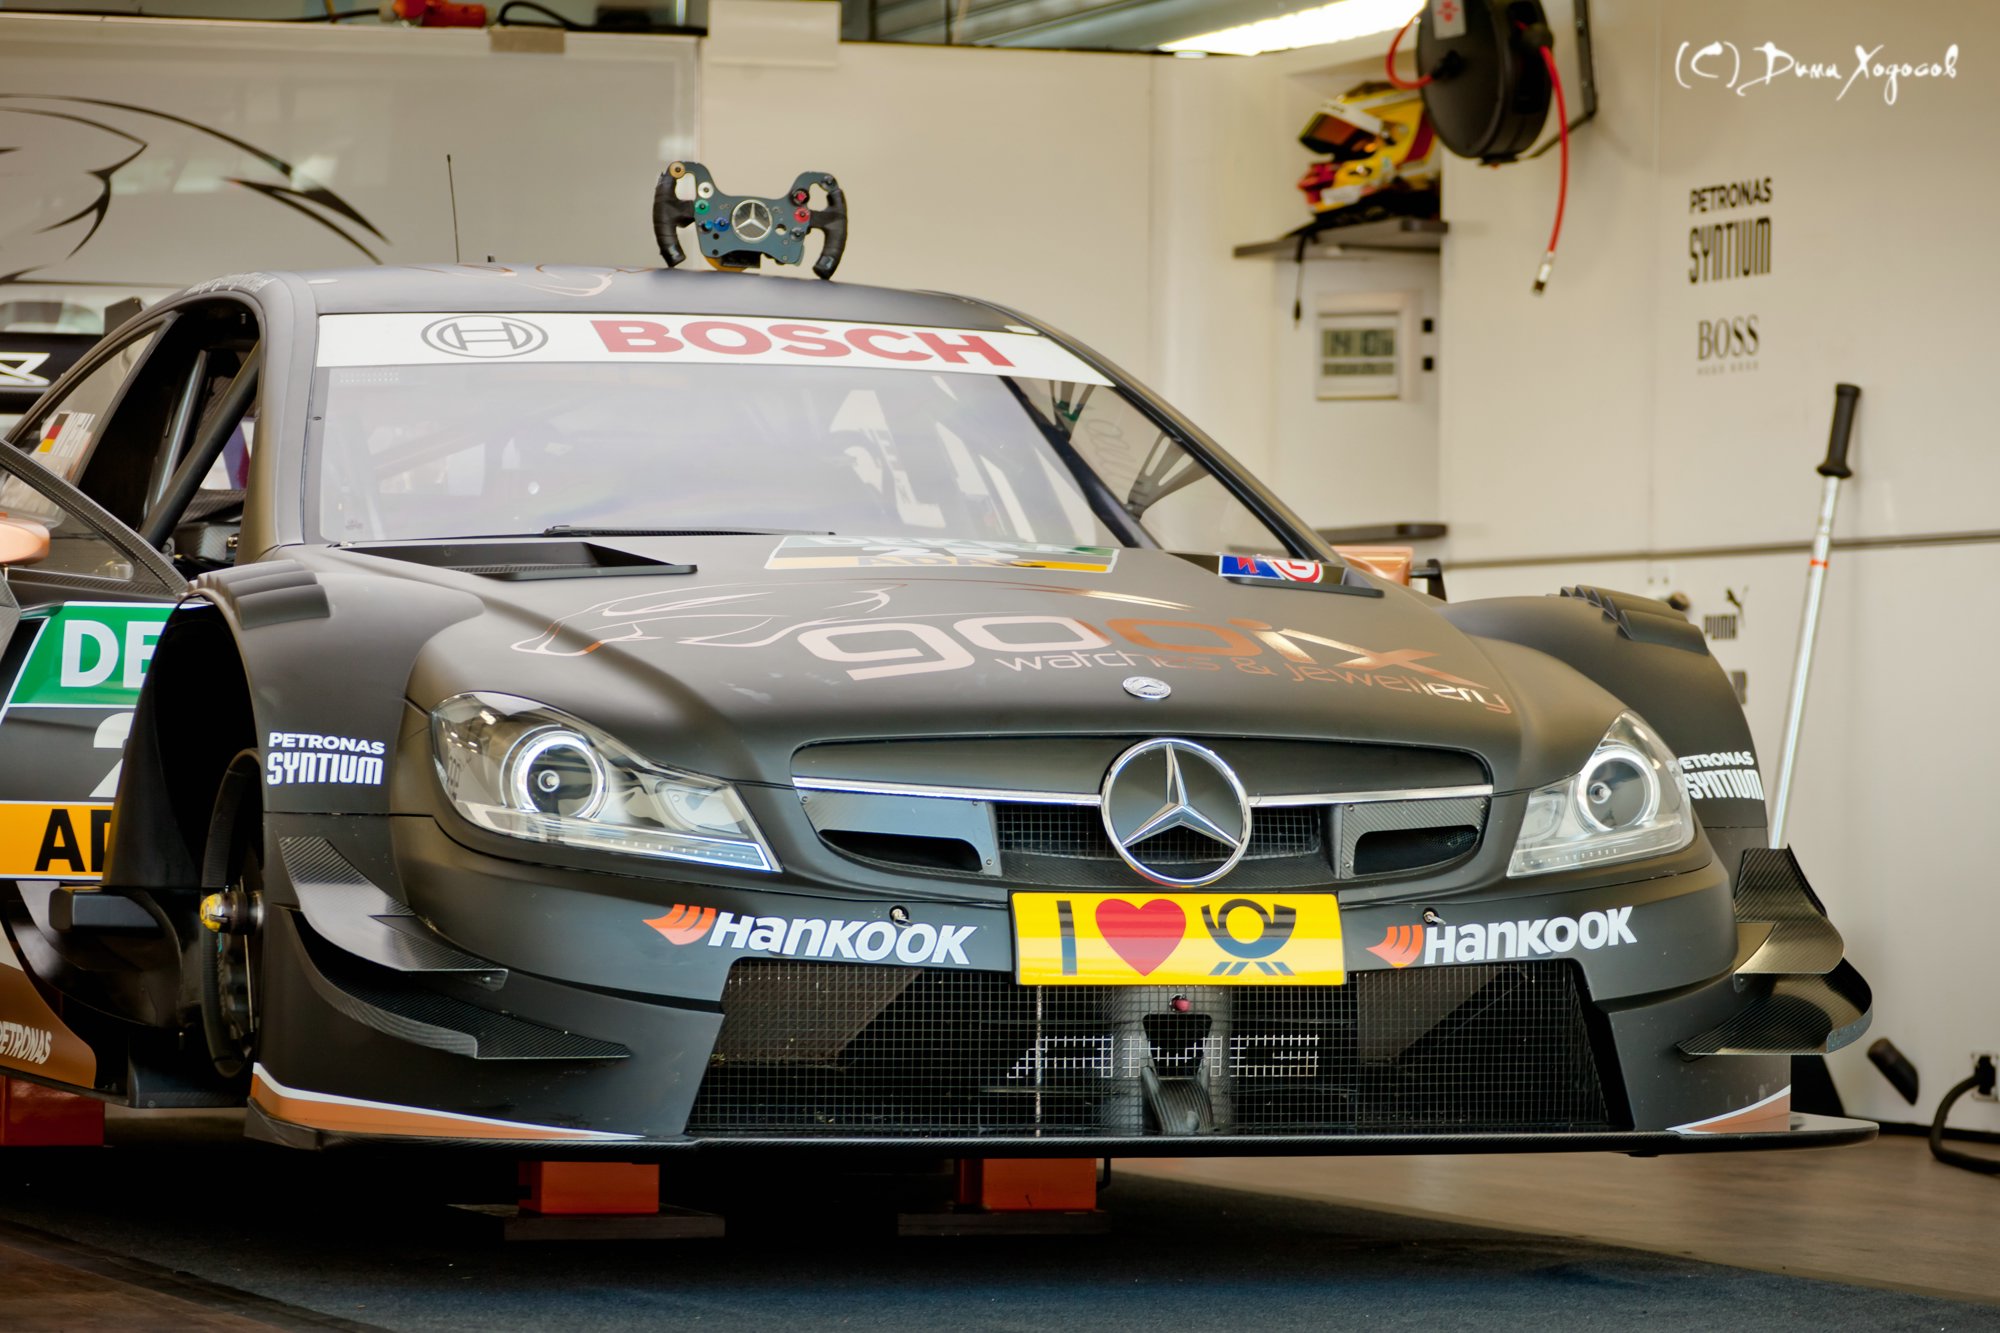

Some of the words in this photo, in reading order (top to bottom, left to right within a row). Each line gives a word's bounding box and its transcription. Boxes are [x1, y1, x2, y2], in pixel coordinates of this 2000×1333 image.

[1689, 177, 1773, 214] PETRONAS
[1689, 216, 1772, 284] SYNTIUM
[589, 320, 1016, 368] BOSCH
[1697, 314, 1760, 361] BOSS
[861, 545, 1020, 560] 25
[1704, 614, 1737, 640] PUMA
[994, 649, 1222, 673] watches
[1230, 657, 1278, 676] &
[1284, 663, 1512, 714] jewellery
[268, 732, 385, 755] PETRONAS
[266, 751, 384, 785] SYNTIUM
[1056, 900, 1078, 977] I
[1006, 1035, 1320, 1078] AMG
